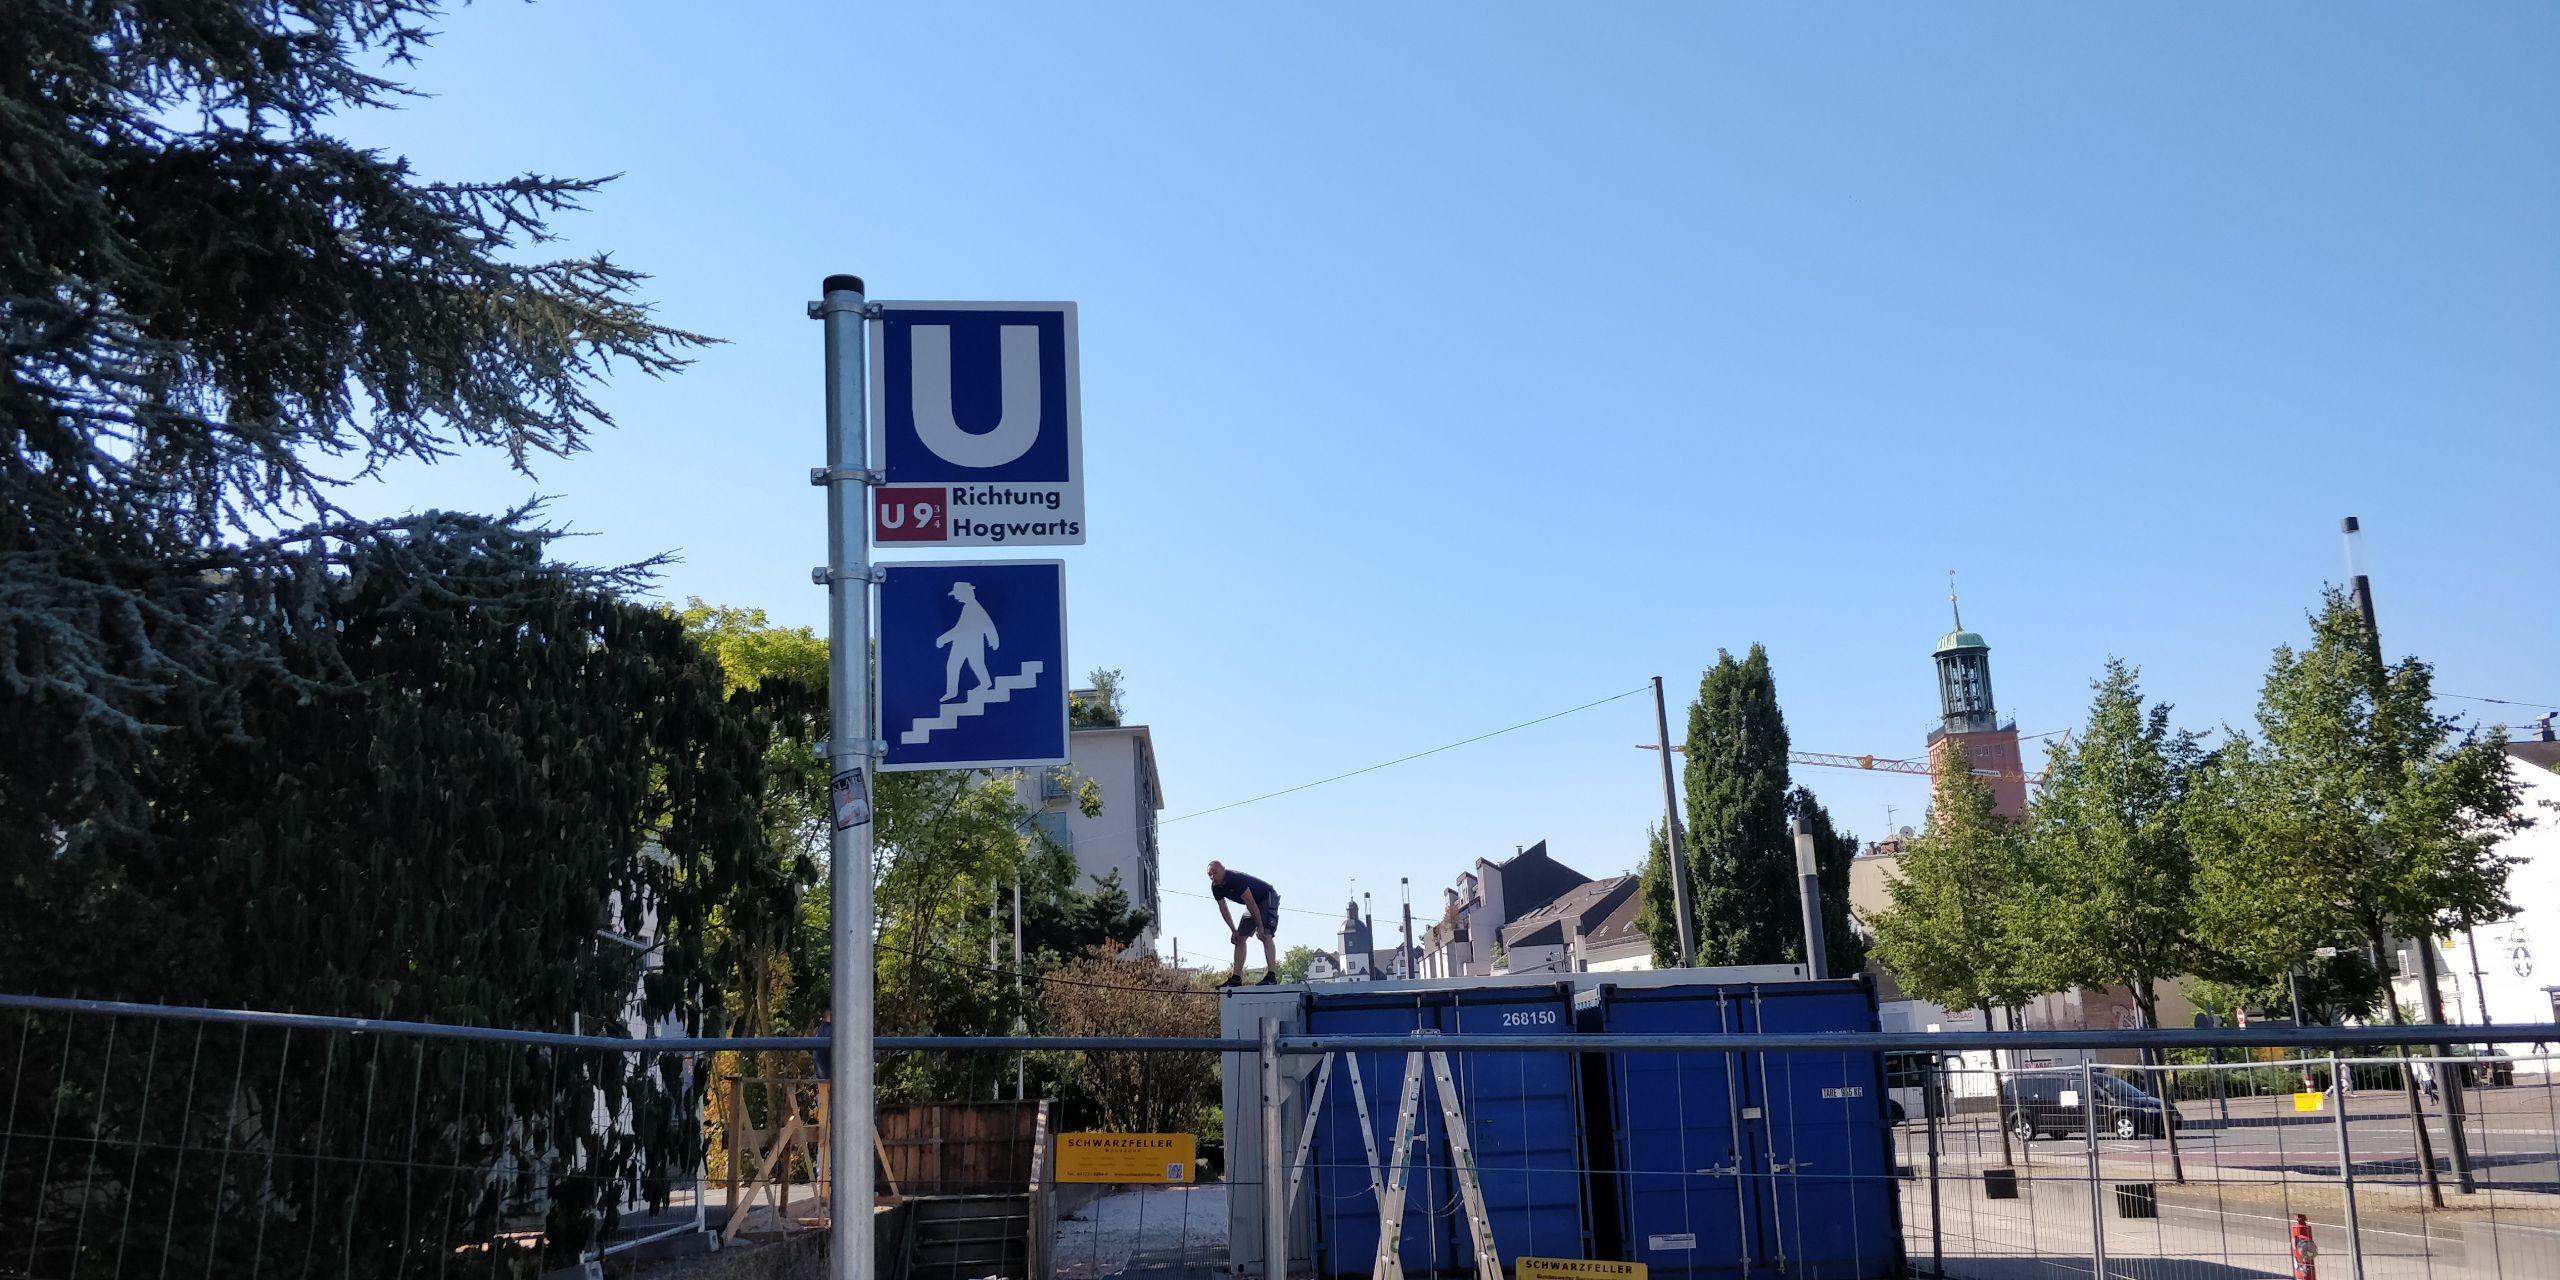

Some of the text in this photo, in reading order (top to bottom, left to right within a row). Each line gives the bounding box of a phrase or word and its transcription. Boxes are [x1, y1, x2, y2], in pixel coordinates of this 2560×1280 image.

[911, 324, 1042, 468] U
[952, 485, 1061, 510] Richtung
[881, 503, 905, 529] U
[953, 518, 1080, 542] Hogwarts
[1502, 1010, 1557, 1027] 268150
[1067, 1138, 1173, 1148] SCHWARZFELLER
[1525, 1259, 1633, 1275] SCHWARZFELLER
